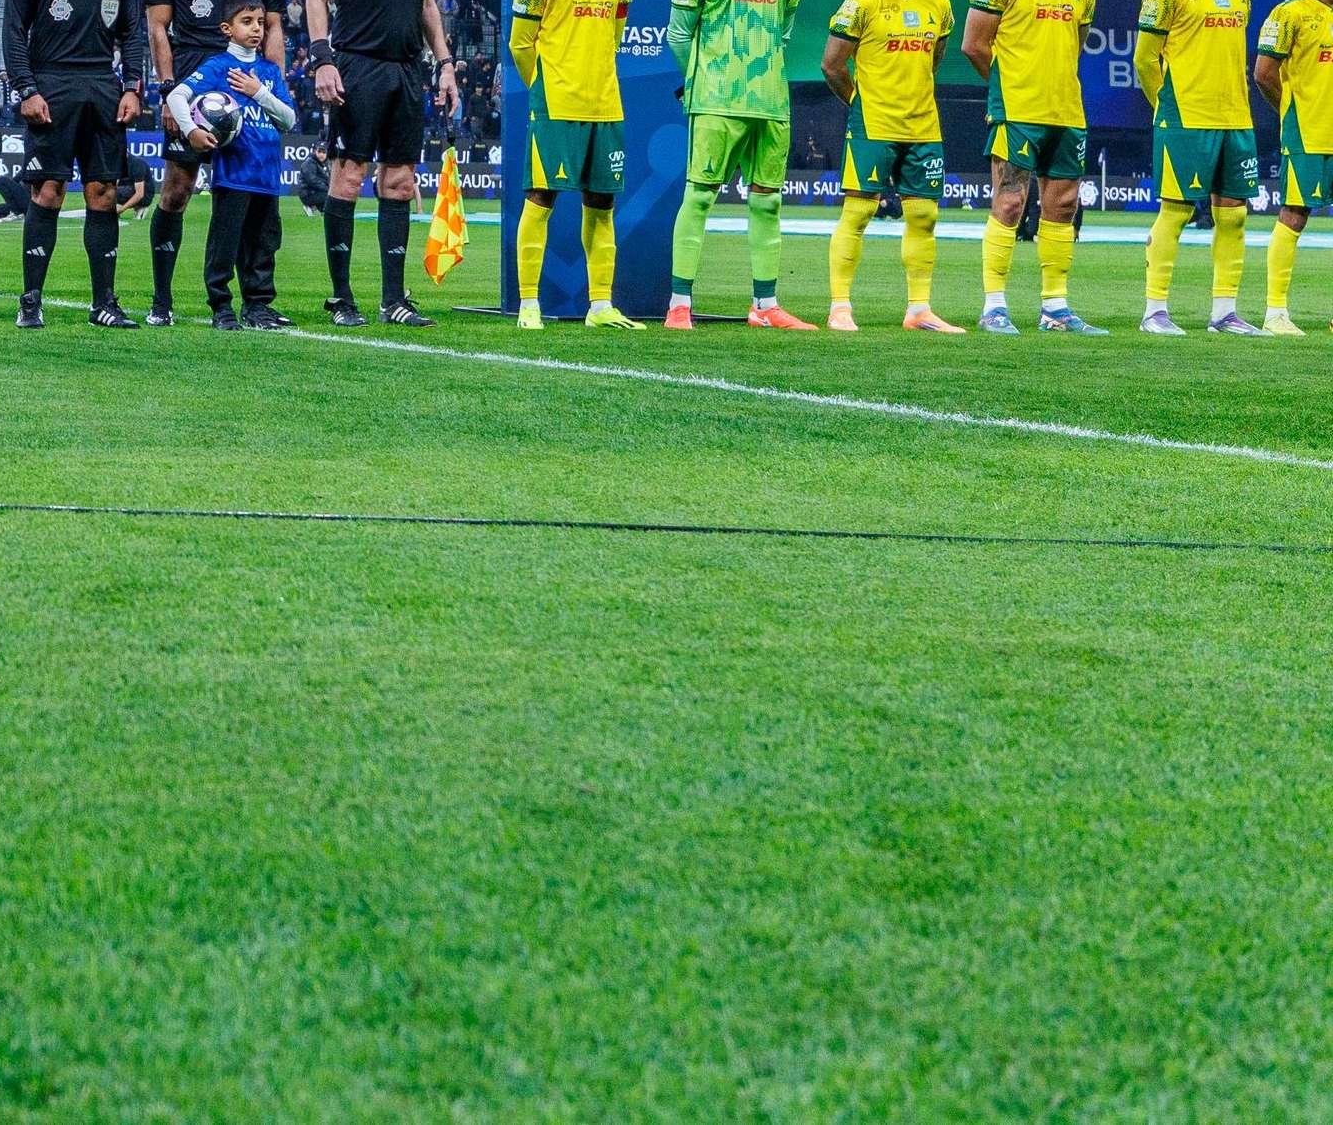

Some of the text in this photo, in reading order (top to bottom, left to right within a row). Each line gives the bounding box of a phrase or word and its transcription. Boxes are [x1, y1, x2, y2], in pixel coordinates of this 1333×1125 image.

[621, 26, 667, 46] TASY
[642, 45, 663, 57] BSF
[886, 39, 934, 53] BASIC
